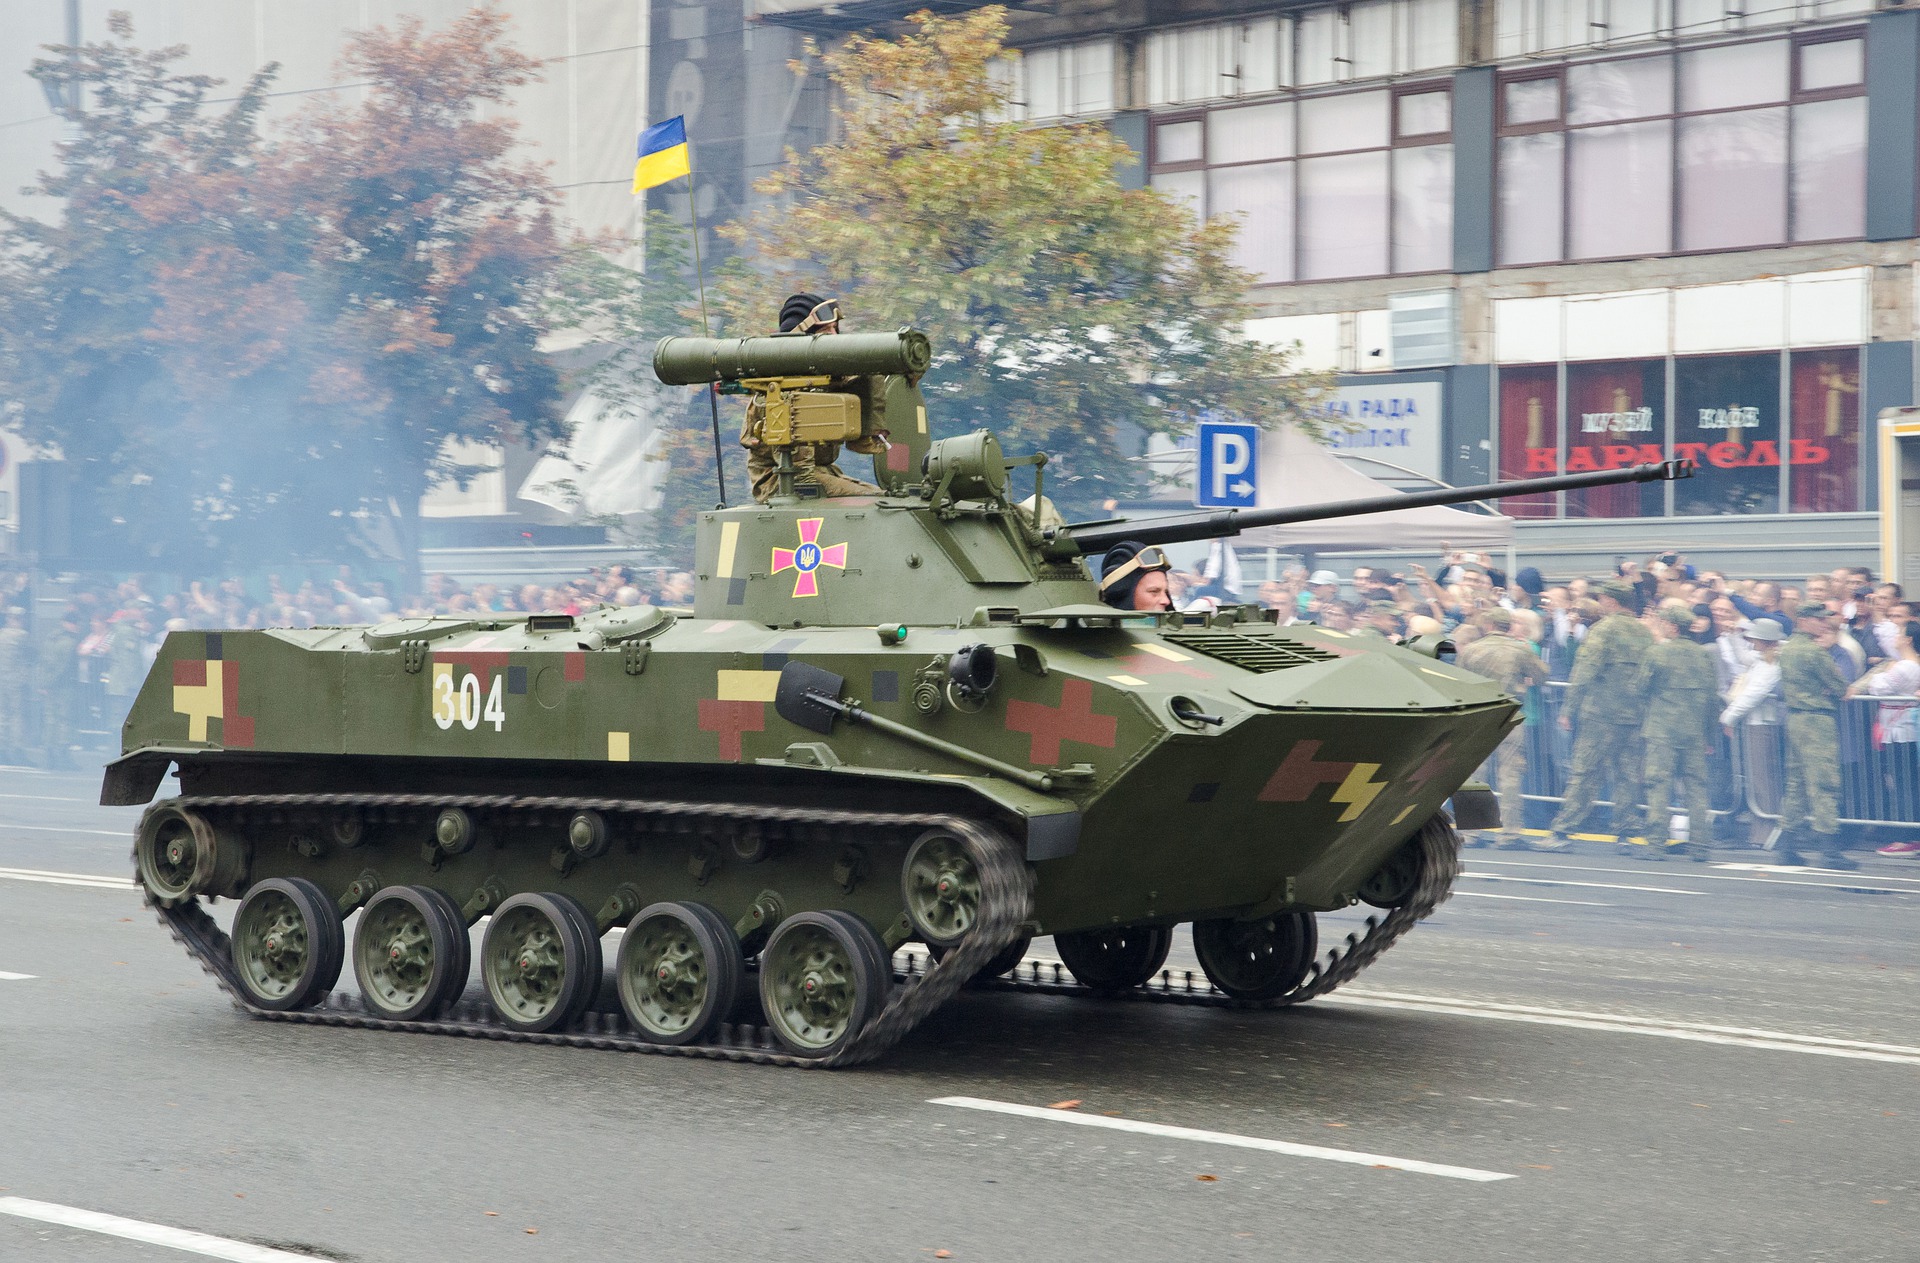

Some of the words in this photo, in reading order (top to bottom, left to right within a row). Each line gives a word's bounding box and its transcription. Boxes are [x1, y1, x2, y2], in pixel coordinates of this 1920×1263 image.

[1359, 398, 1419, 420] РАДА
[1580, 406, 1653, 433] МУЗЕЙ
[1697, 407, 1760, 429] КАФЕ
[1212, 433, 1250, 498] P
[435, 673, 505, 732] 304
